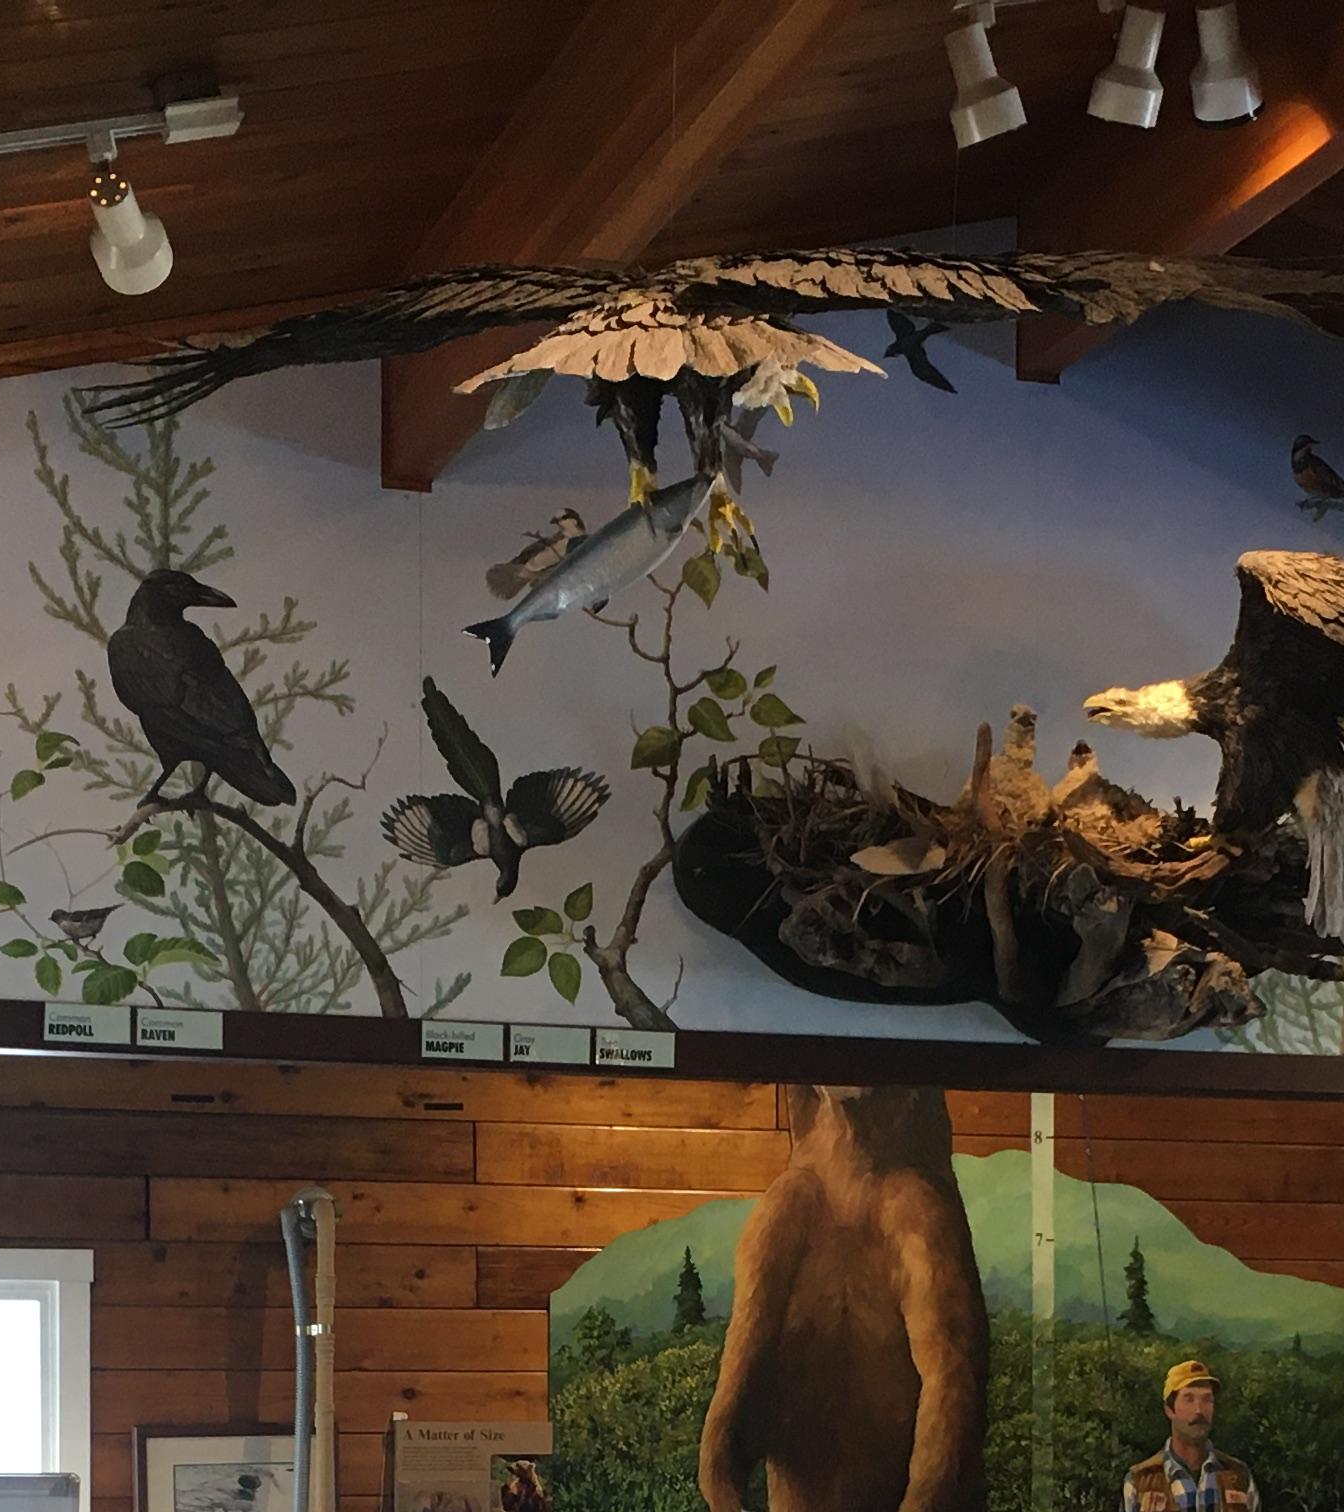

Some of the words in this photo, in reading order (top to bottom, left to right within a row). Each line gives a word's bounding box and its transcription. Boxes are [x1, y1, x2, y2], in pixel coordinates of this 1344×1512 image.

[48, 1024, 94, 1037] REDPOLL
[141, 1029, 176, 1042] RAVEN
[425, 1041, 465, 1054] MAGPIE
[514, 1045, 530, 1057] JAY
[599, 1048, 653, 1061] SWALLOWS
[403, 1429, 414, 1441] A
[417, 1427, 460, 1441] Matter
[463, 1427, 475, 1441] of
[480, 1427, 506, 1441] Size
